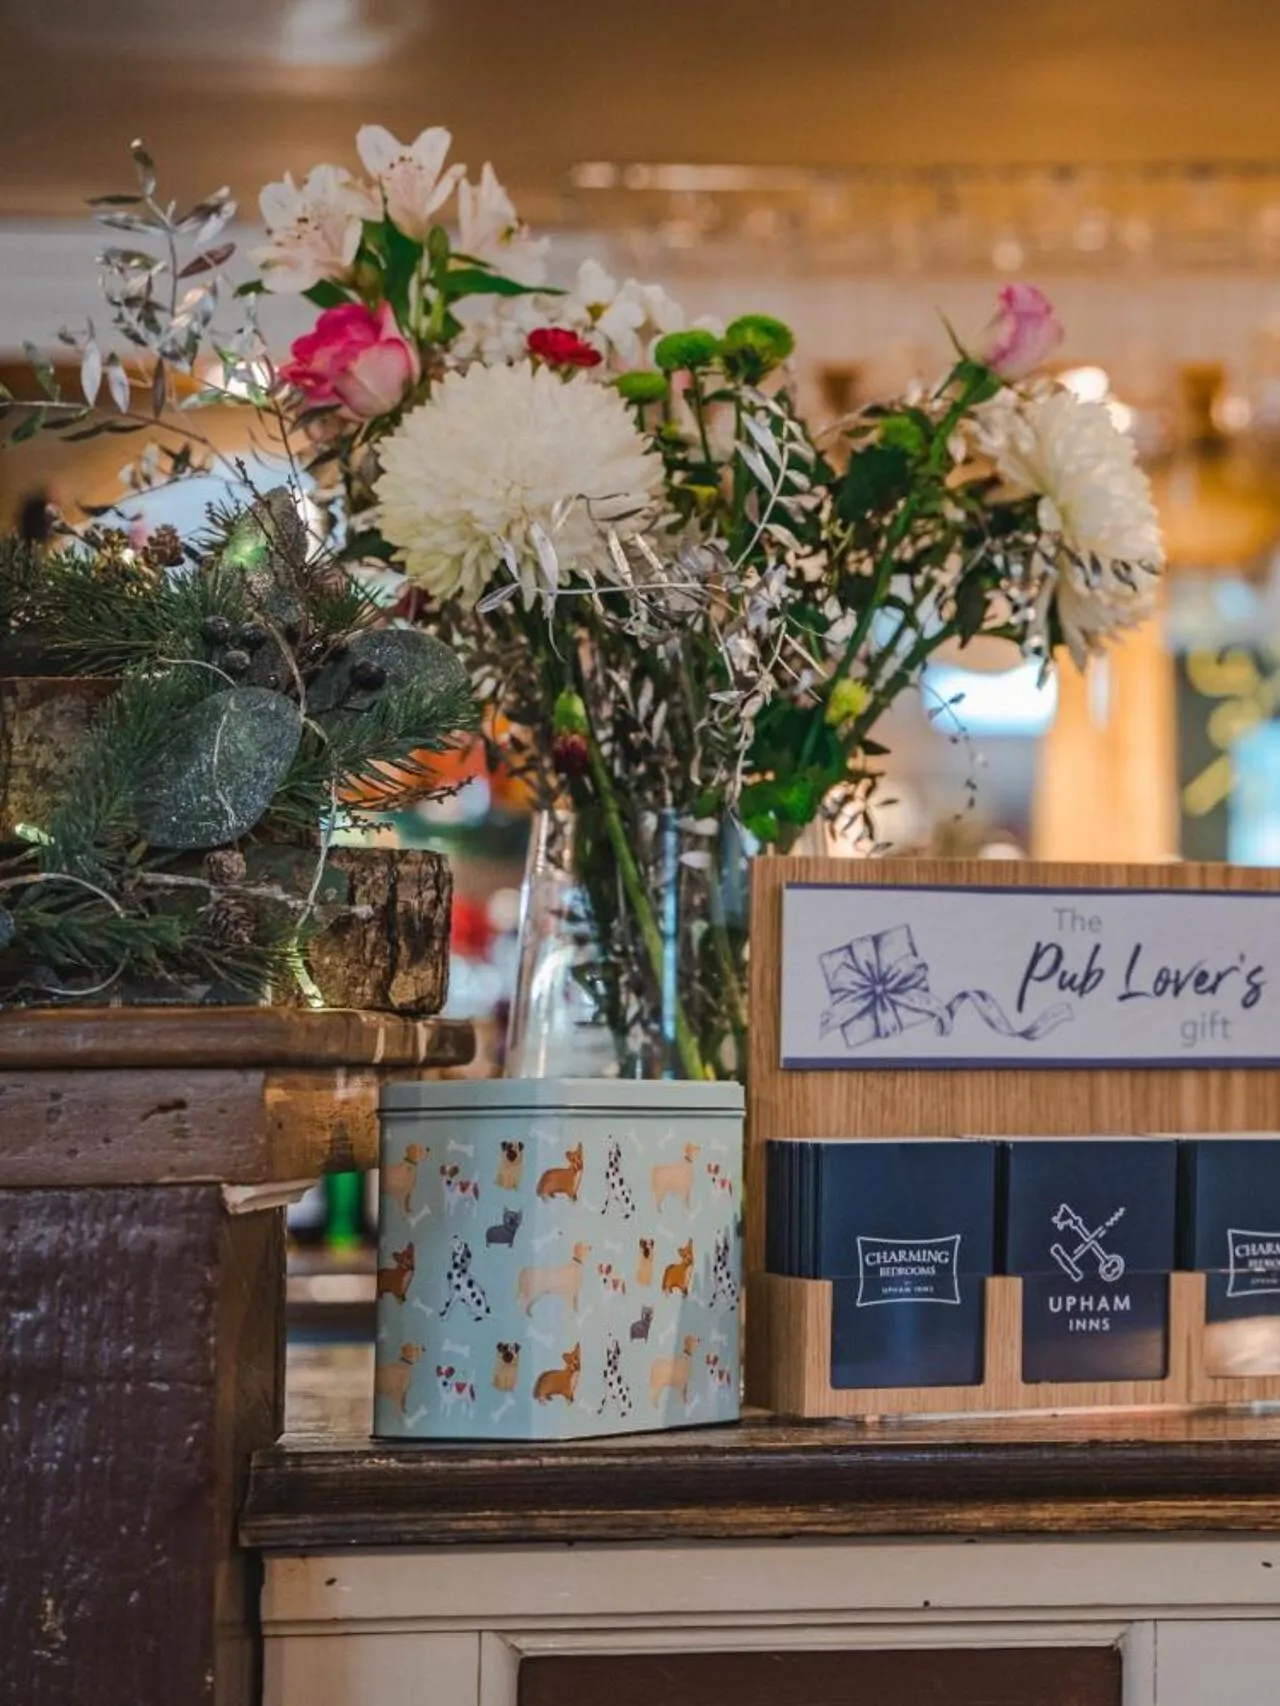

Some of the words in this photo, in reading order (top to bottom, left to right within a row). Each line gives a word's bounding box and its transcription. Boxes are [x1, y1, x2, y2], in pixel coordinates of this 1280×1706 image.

[1053, 907, 1103, 933] The
[1017, 942, 1105, 1013] Pub
[1117, 943, 1267, 1009] Lover's
[1180, 1012, 1232, 1048] gift
[865, 1249, 950, 1266] CHARMING
[1048, 1294, 1131, 1313] UPHAM
[1068, 1318, 1110, 1332] INNS
